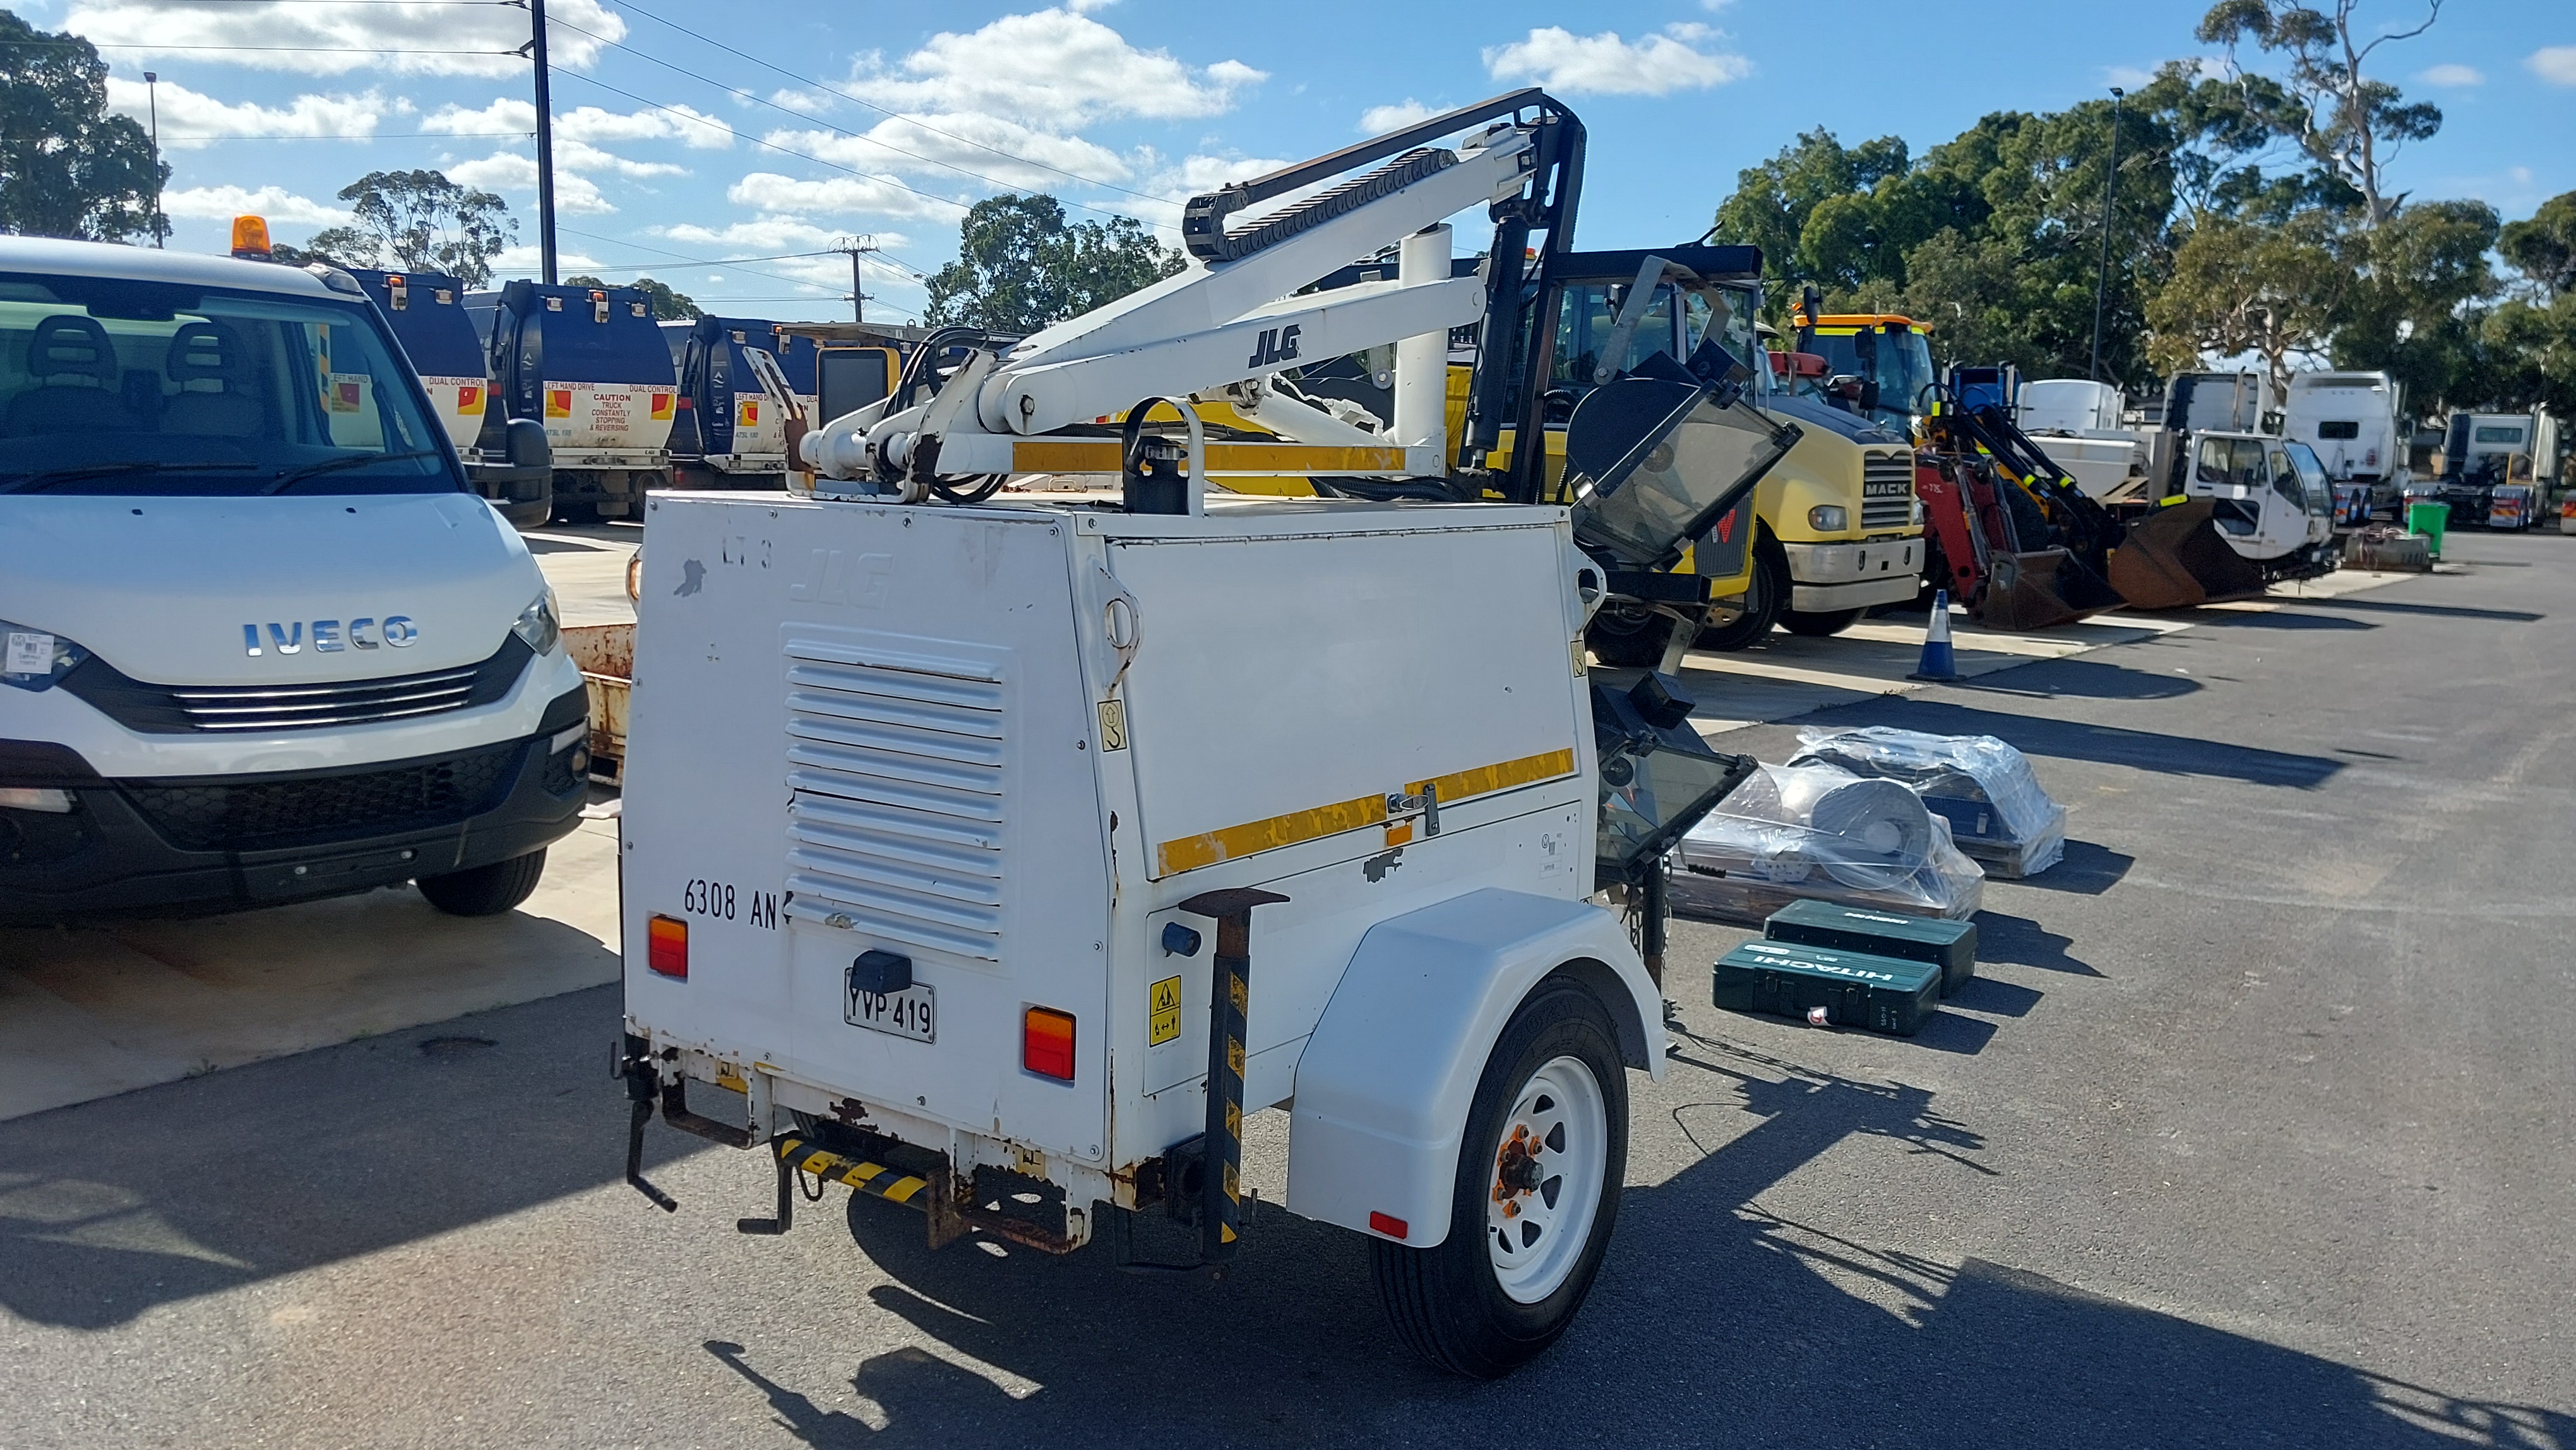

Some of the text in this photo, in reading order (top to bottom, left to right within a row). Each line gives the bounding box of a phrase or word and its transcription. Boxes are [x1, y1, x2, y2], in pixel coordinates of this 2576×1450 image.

[1248, 323, 1302, 369] JLG
[349, 374, 368, 383] HAND
[429, 377, 484, 386] DUAL CONTROL
[629, 385, 677, 393] DUAL CONTROL
[1866, 484, 1907, 494] MACK
[789, 548, 895, 609] JLG
[243, 616, 418, 656] IVECO
[685, 878, 777, 930] 6308 AN
[1753, 956, 1893, 981] HITACHI
